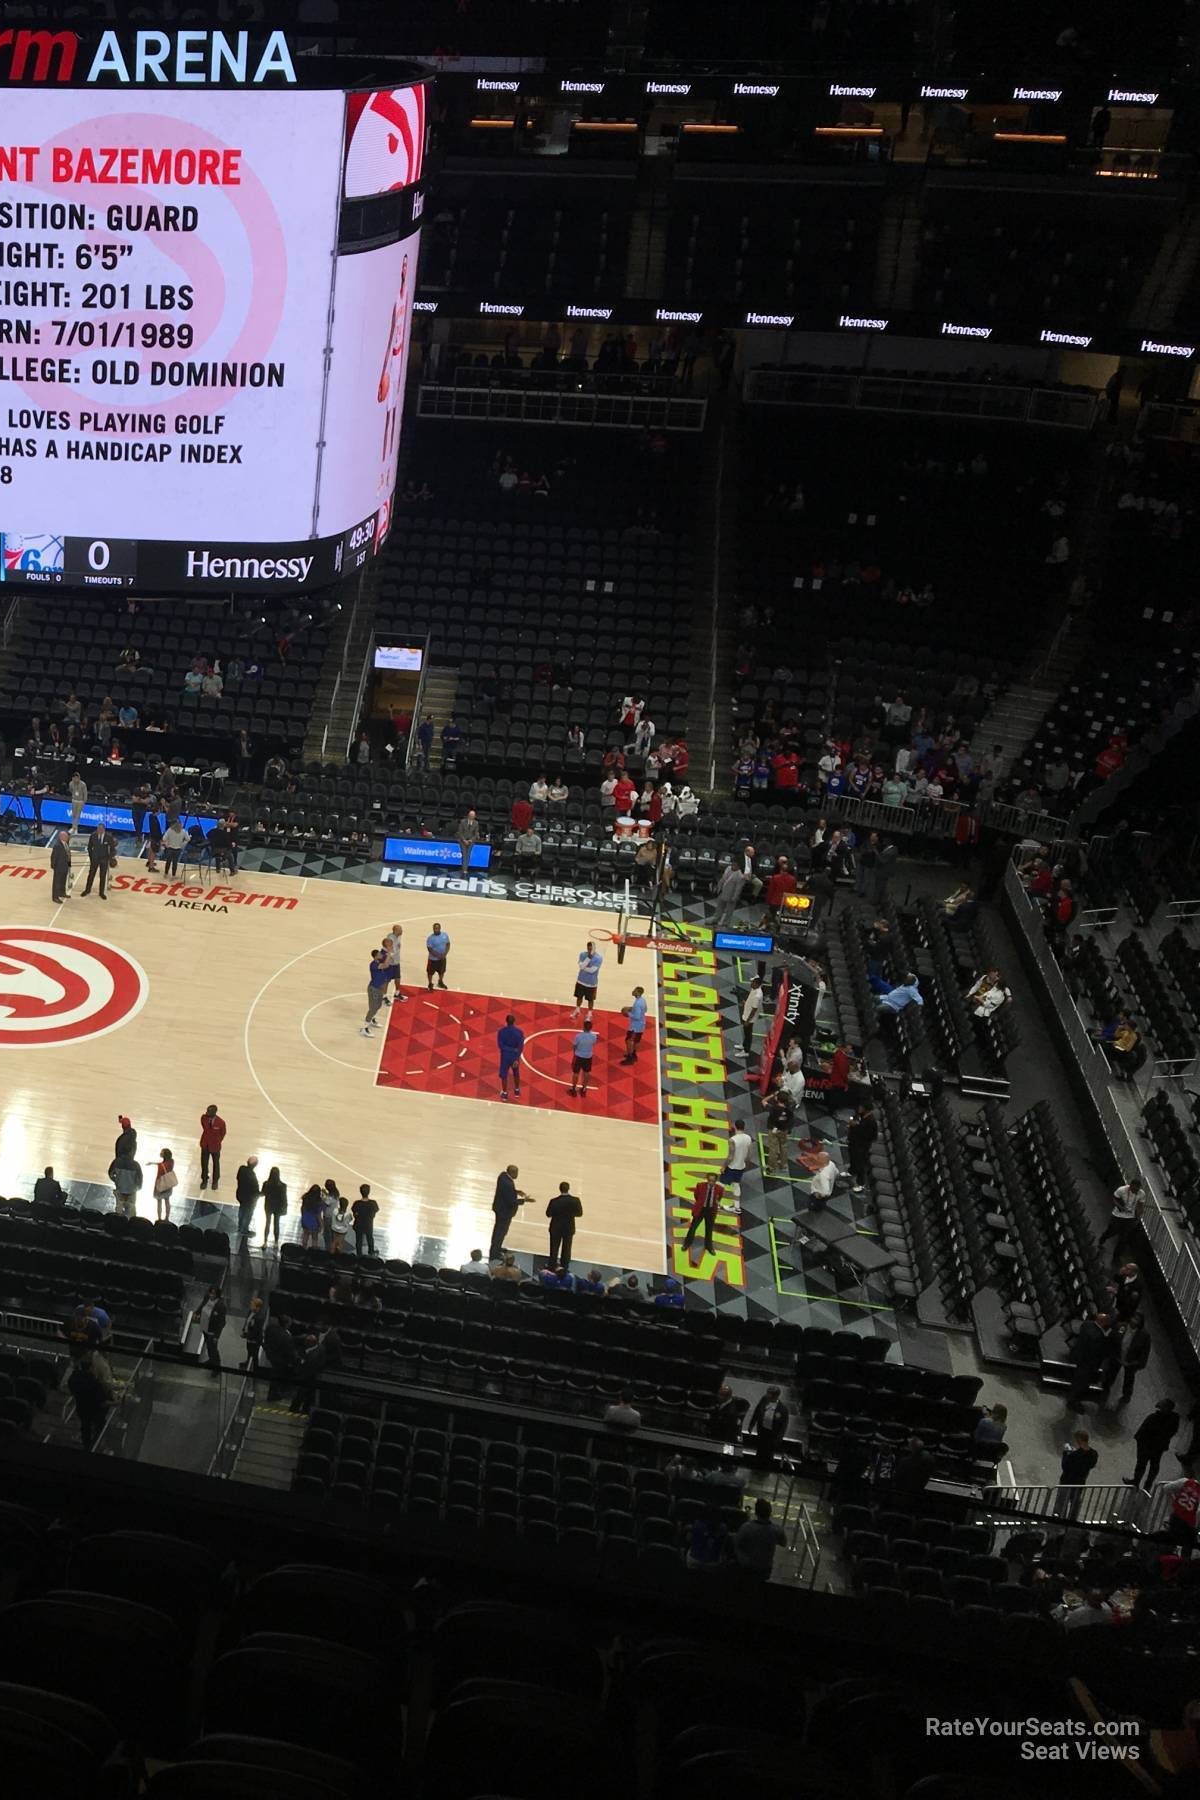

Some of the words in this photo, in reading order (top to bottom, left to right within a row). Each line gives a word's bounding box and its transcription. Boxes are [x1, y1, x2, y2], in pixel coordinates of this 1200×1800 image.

[87, 30, 298, 83] ARENA
[476, 78, 520, 92] Hennessy
[560, 80, 606, 94] Hennessy
[646, 81, 692, 95] Hennessy
[733, 82, 780, 97] Hennessy
[829, 84, 877, 98] Hennessy
[920, 85, 969, 100] Hennessy
[1012, 87, 1063, 102] Hennessy
[1107, 89, 1160, 105] Hennessy
[52, 147, 242, 185] BAZEMORE
[106, 204, 199, 233] GUARD
[81, 282, 130, 310] 201
[145, 284, 194, 311] LBS
[479, 301, 525, 316] Hennessy
[566, 305, 613, 320] Hennessy
[655, 308, 703, 323] Hennessy
[746, 312, 795, 327] Hennessy
[839, 315, 889, 331] Hennessy
[51, 320, 194, 350] 7/01/1989
[941, 322, 993, 339] Hennessy
[1039, 329, 1093, 348] Hennessy
[1140, 340, 1196, 358] Hennessy
[91, 359, 140, 386] OLD
[150, 361, 285, 388] DOMINION
[8, 408, 71, 431] LOVES
[79, 411, 166, 434] PLAYING
[174, 414, 226, 435] GOLF
[44, 439, 59, 459] A
[66, 440, 172, 463] HANDICAP
[180, 443, 243, 465] INDEX
[88, 540, 110, 571] 0
[186, 550, 314, 583] Hennessy
[26, 572, 51, 581] FOULS
[55, 574, 62, 582] 0
[84, 575, 122, 585] TIMEOUTS
[66, 807, 104, 822] Wlmart
[403, 846, 439, 857] Walmart
[451, 851, 463, 859] co
[380, 867, 507, 895] Harrah's
[515, 890, 577, 904] Casino
[165, 899, 229, 913] ARENA
